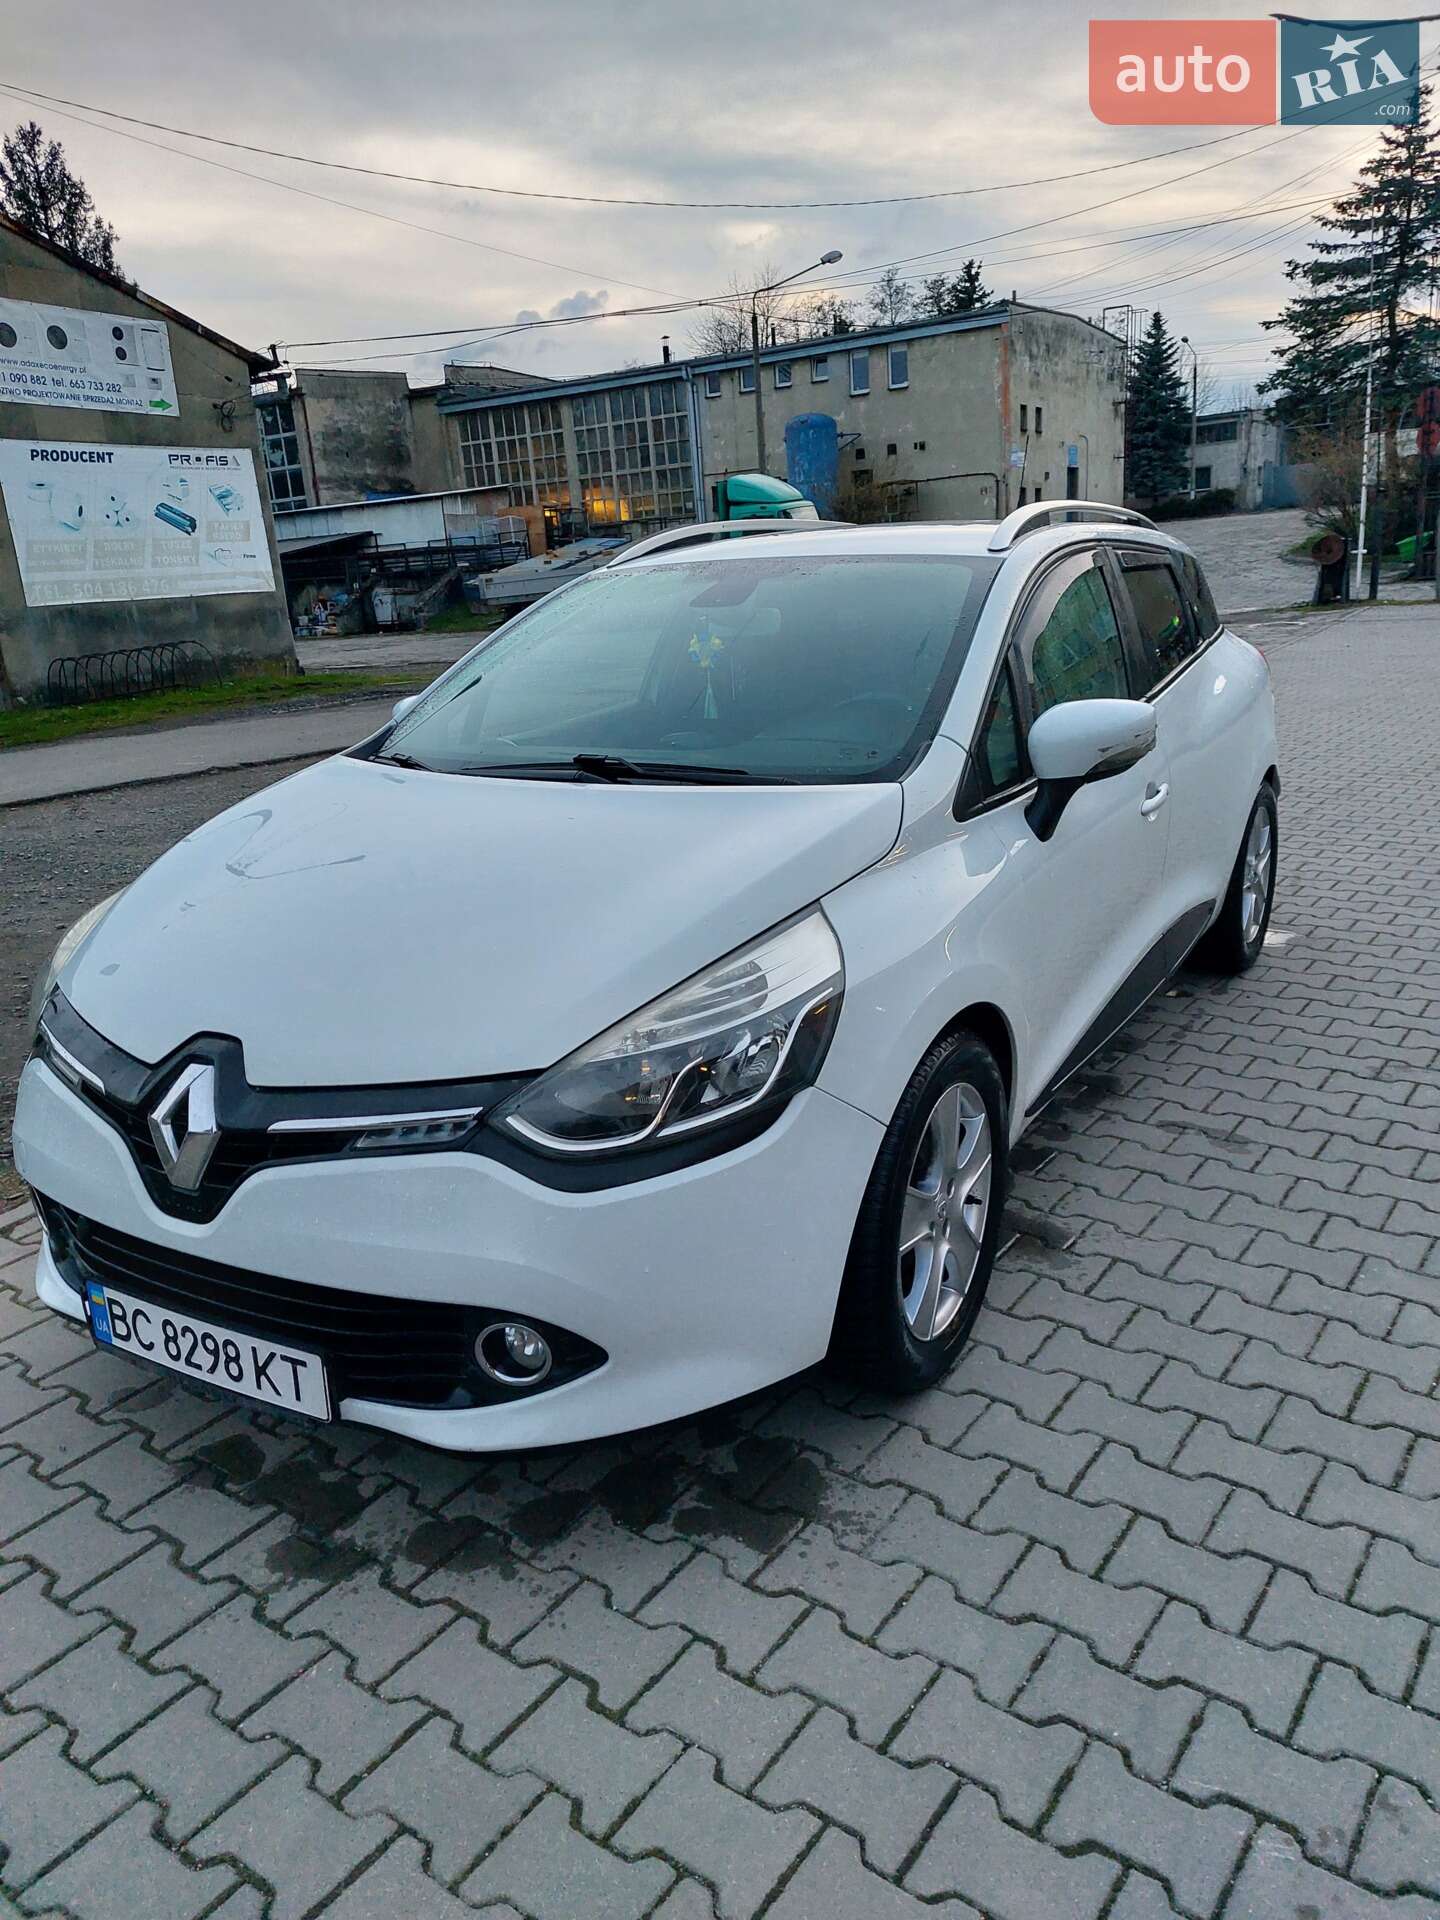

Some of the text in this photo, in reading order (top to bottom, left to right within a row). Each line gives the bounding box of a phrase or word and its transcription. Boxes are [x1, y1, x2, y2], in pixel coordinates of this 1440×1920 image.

[10, 372, 27, 383] 090
[30, 374, 47, 386] 882
[51, 377, 67, 388] tel.
[69, 379, 85, 390] 663
[88, 381, 104, 391] 733
[105, 382, 122, 393] 282
[30, 449, 114, 464] PRODUCENT
[95, 1317, 109, 1333] UA
[106, 1296, 308, 1402] BC 8298 KT
